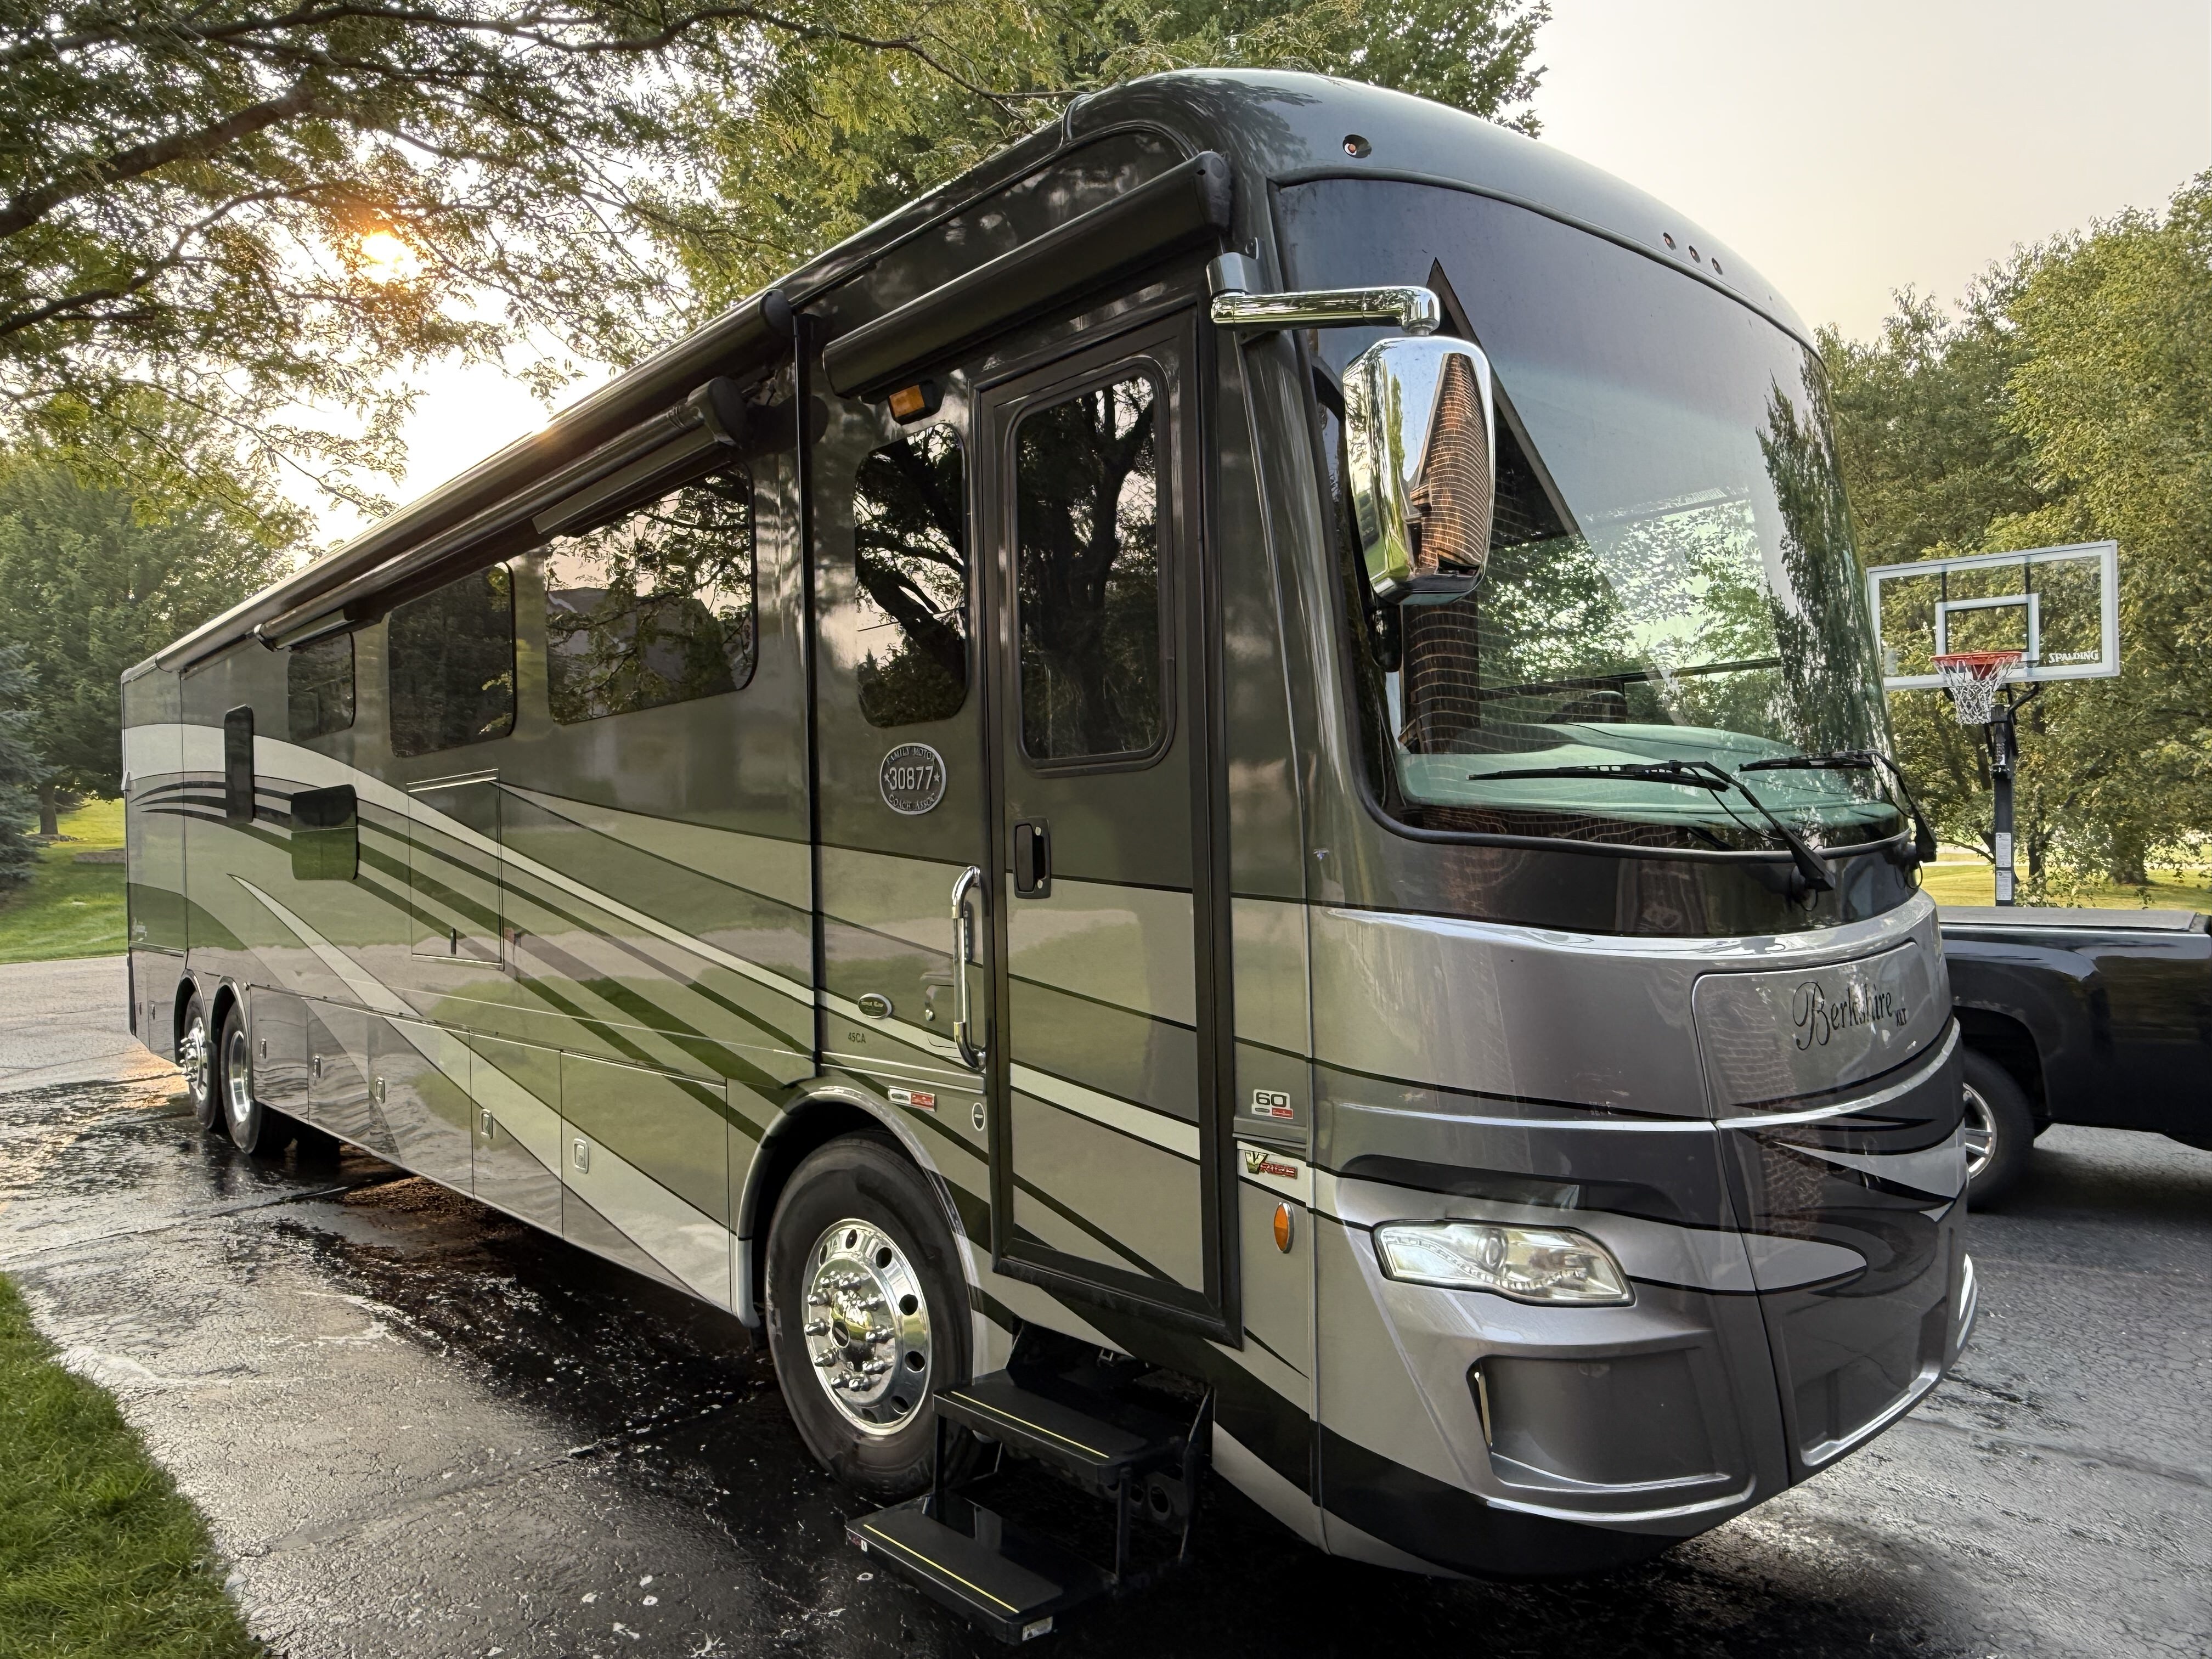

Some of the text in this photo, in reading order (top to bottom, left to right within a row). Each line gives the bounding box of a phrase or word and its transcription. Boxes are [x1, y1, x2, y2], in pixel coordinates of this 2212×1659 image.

[2049, 650, 2099, 663] SPALDING
[889, 765, 934, 791] 30877
[1792, 981, 1893, 1051] Berkshire
[1256, 1092, 1287, 1108] 60
